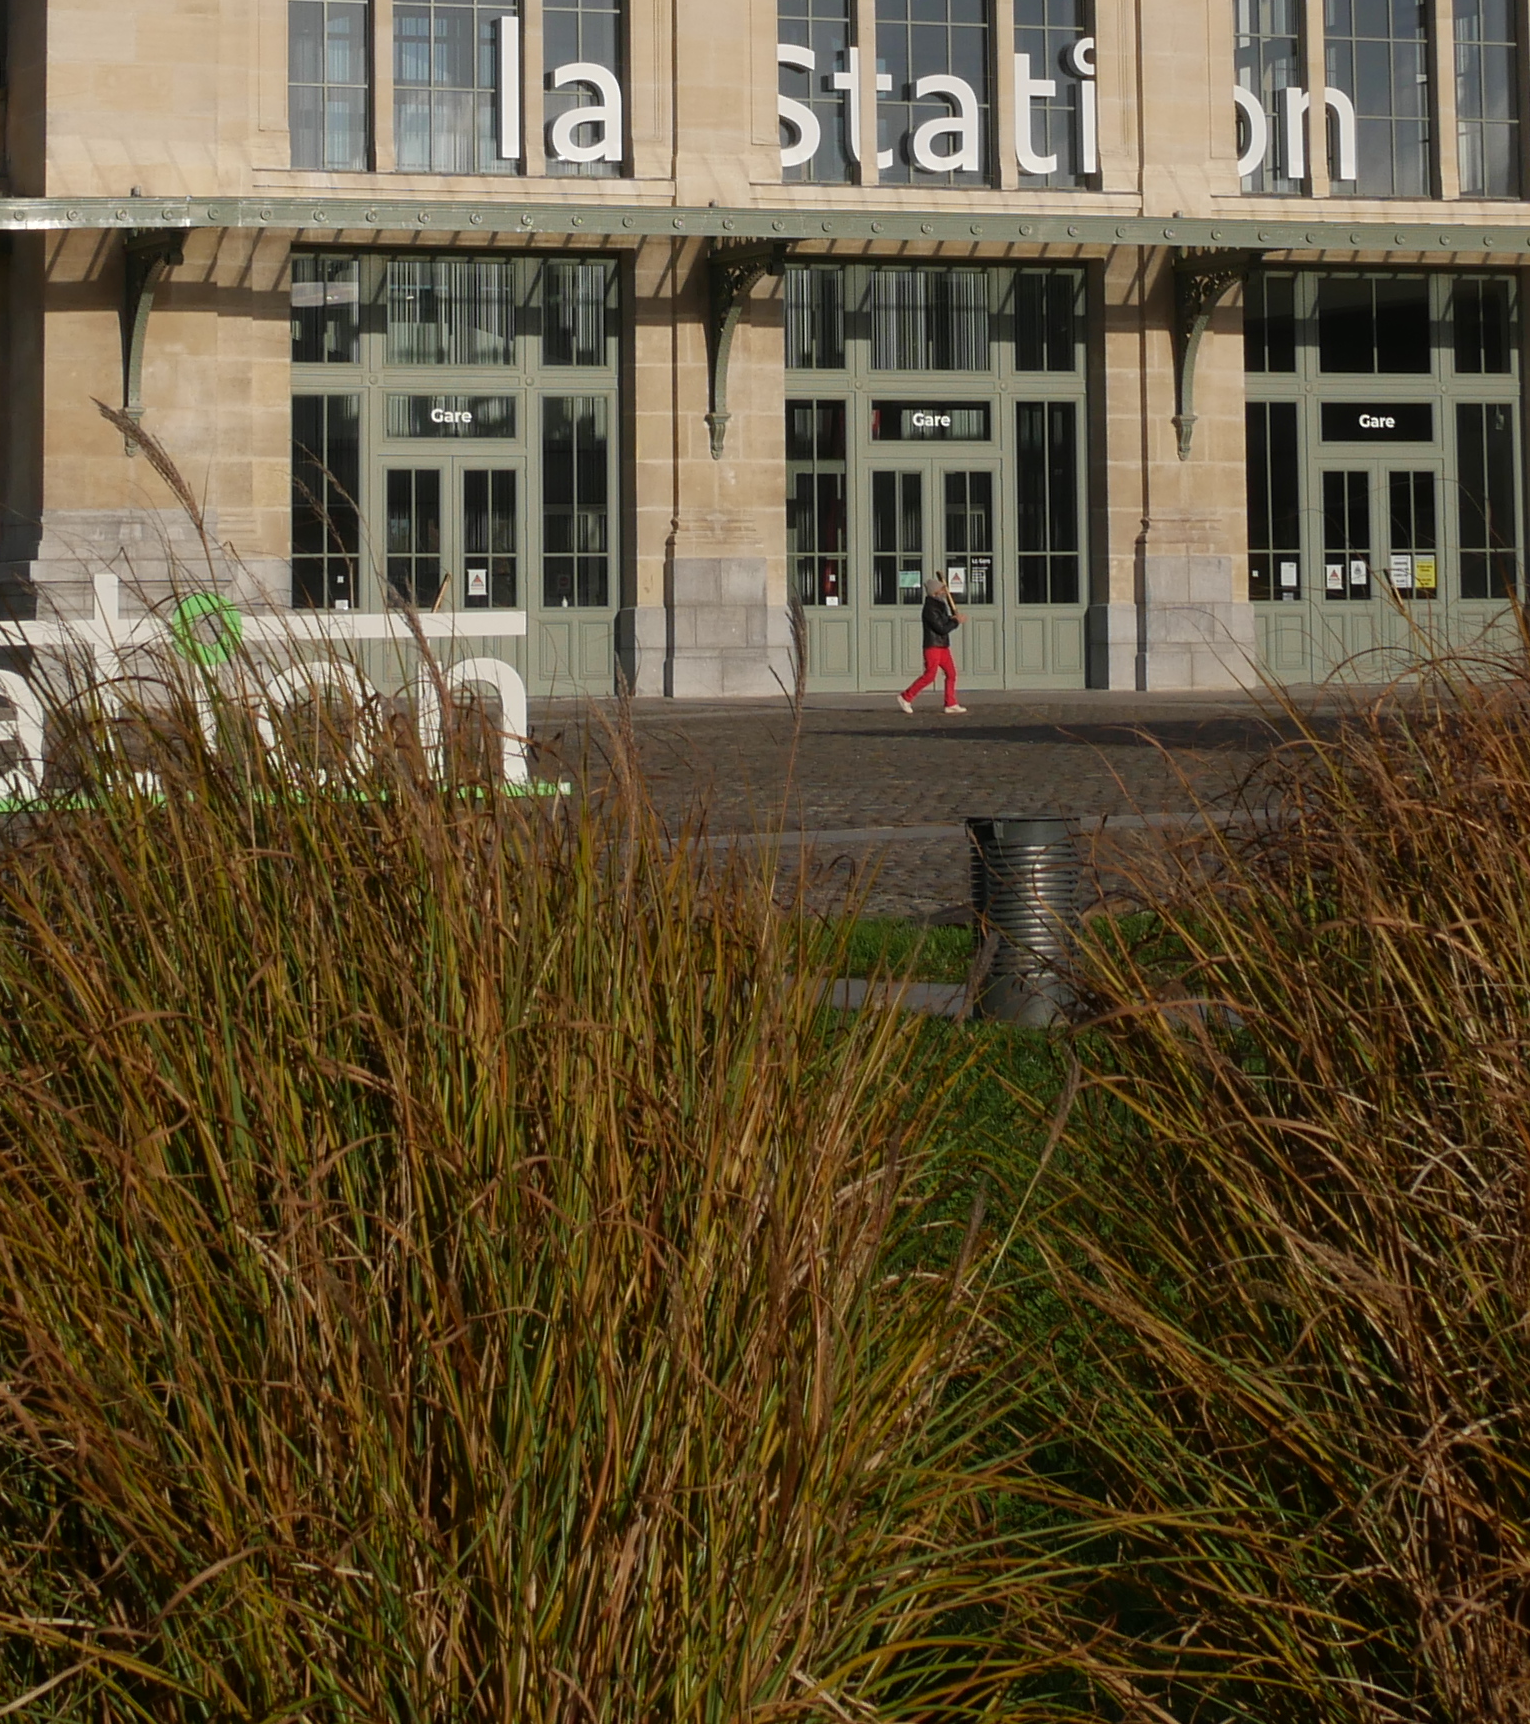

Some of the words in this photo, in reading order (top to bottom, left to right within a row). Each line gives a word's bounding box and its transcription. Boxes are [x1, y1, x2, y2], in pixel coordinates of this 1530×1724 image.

[501, 16, 622, 162] la
[431, 408, 472, 423] Gare
[912, 412, 951, 427] Gare
[1359, 414, 1396, 428] Gare
